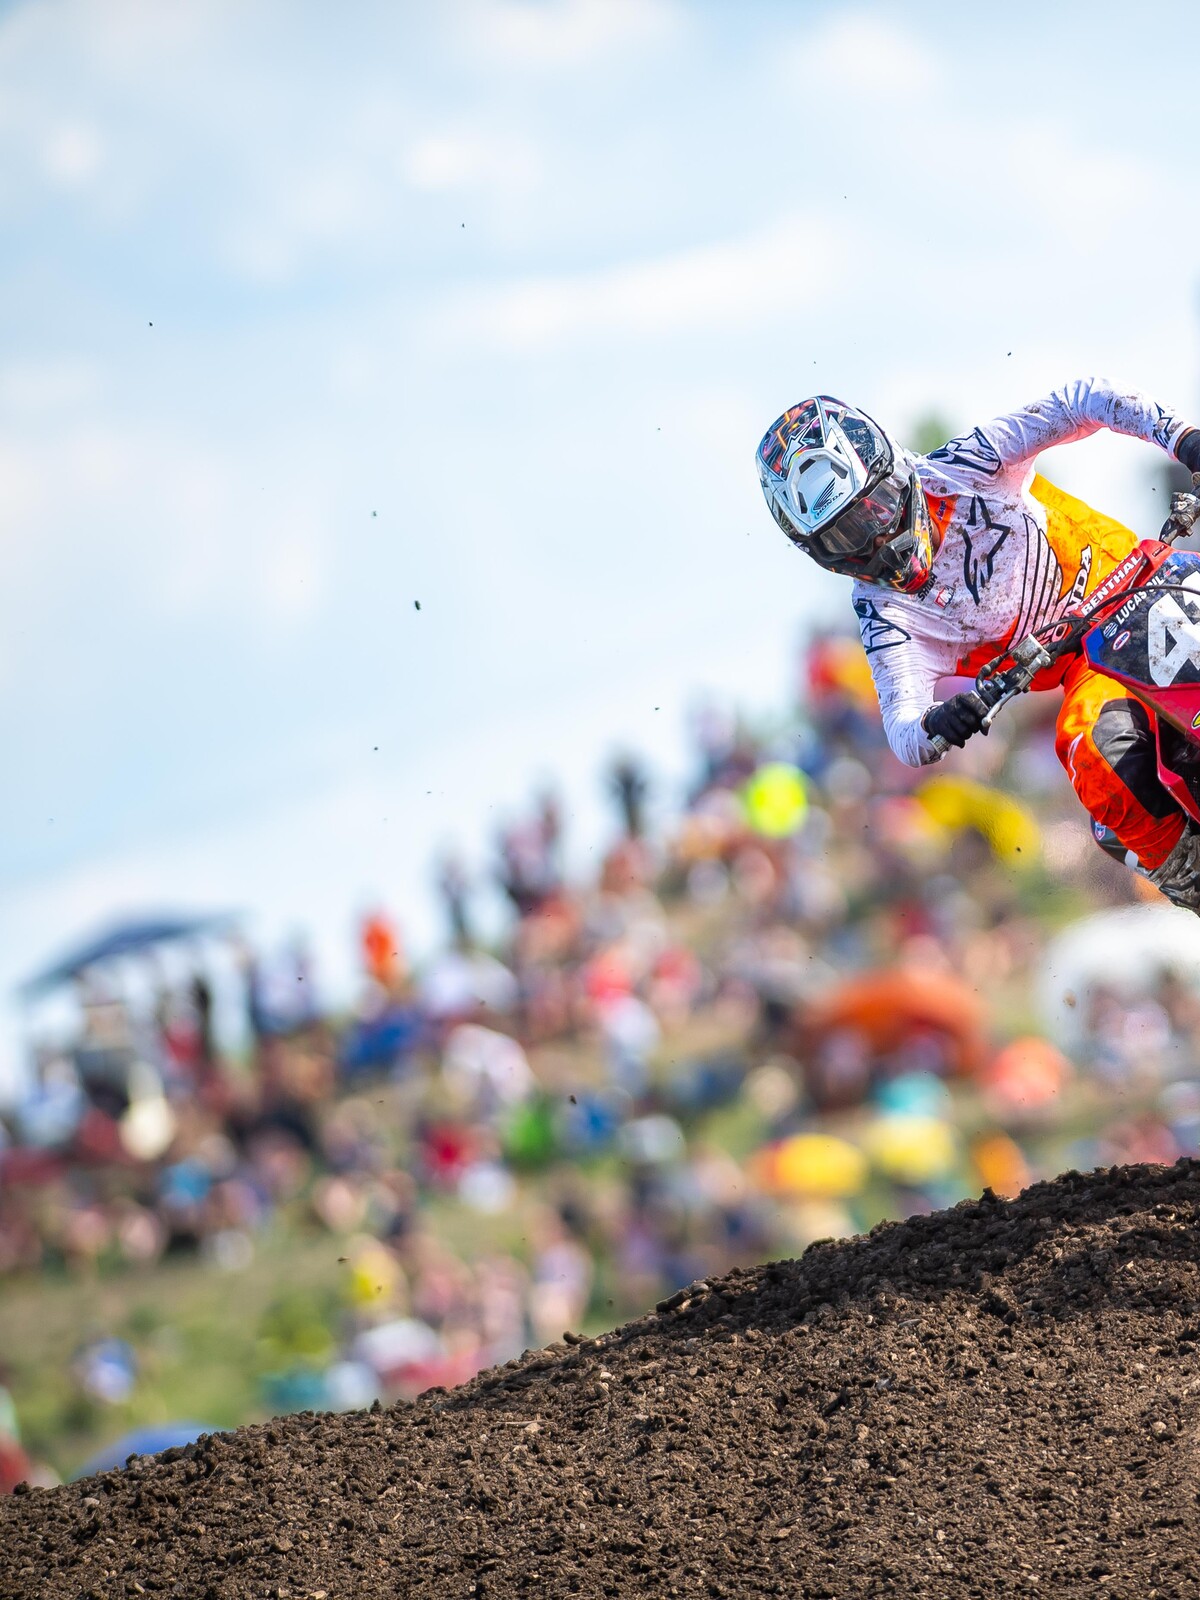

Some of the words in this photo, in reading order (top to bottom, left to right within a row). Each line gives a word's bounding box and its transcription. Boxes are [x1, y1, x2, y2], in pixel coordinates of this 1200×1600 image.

[816, 491, 844, 517] HONDA
[1049, 544, 1092, 643] ONDA
[1081, 554, 1142, 617] RENTHAL
[1115, 589, 1148, 625] LUCAS
